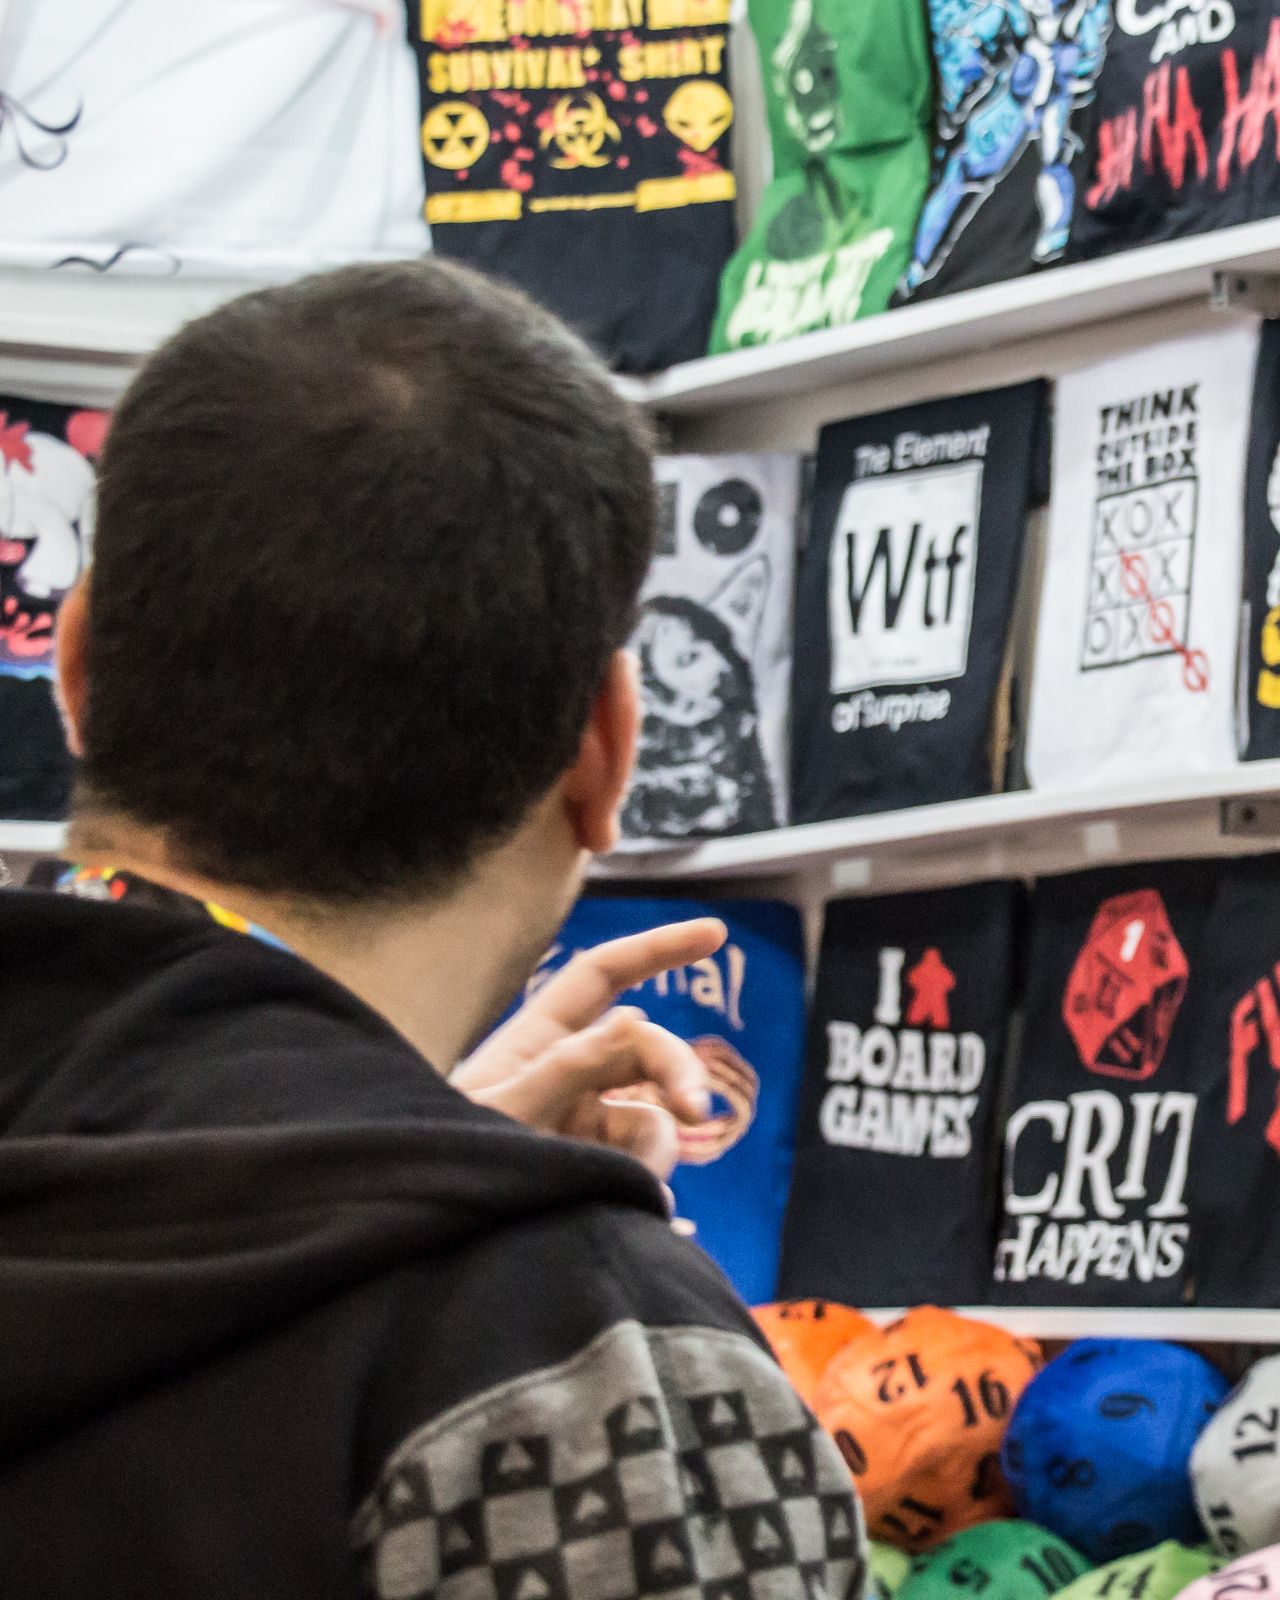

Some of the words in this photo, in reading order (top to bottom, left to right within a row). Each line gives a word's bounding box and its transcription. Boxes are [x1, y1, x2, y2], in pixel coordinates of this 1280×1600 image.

[618, 36, 726, 82] SHIRT
[1149, 0, 1237, 64] AND
[1100, 382, 1199, 434] THINK
[854, 444, 890, 480] The
[893, 424, 990, 470] Element
[1096, 461, 1133, 486] THE
[1145, 448, 1196, 478] BOX
[1098, 421, 1196, 462] OUTSIDE
[845, 522, 968, 636] Wtf
[832, 690, 872, 734] of
[862, 685, 951, 732] Surprise
[874, 946, 905, 1026] I
[826, 1020, 987, 1093] BOARD
[818, 1084, 979, 1160] GAMES
[1004, 1089, 1198, 1221] CRIT
[994, 1214, 1191, 1284] HAPPENS
[1232, 1405, 1280, 1464] 12
